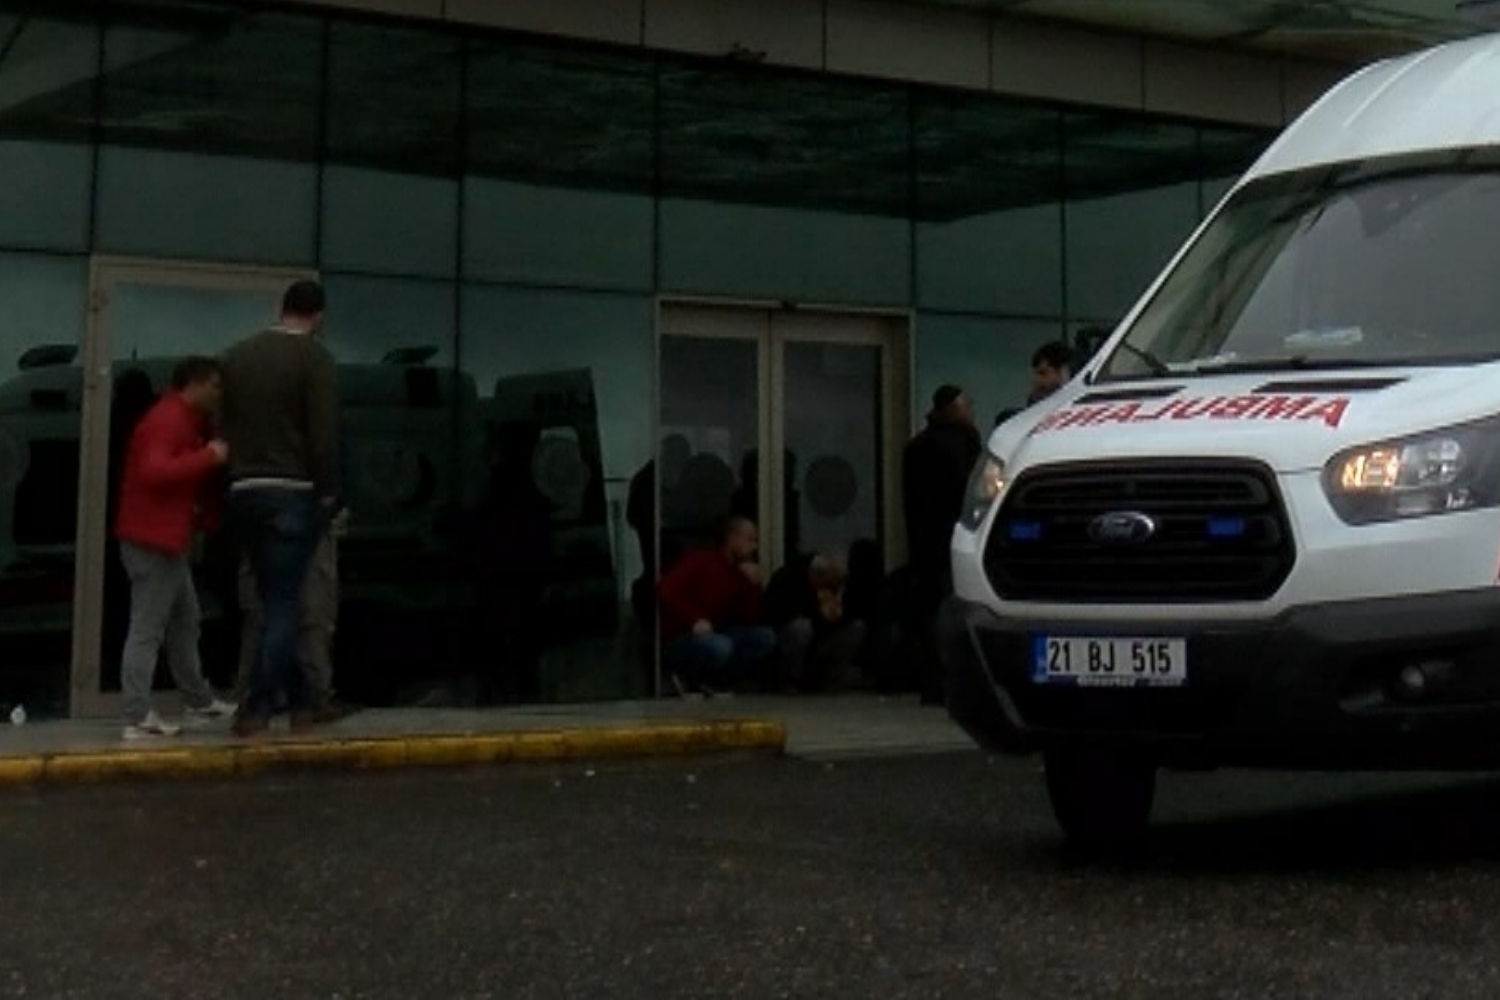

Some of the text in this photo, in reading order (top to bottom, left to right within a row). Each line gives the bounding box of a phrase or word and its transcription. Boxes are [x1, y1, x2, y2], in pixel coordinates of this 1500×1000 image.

[1049, 640, 1172, 674] 21 BJ 515
